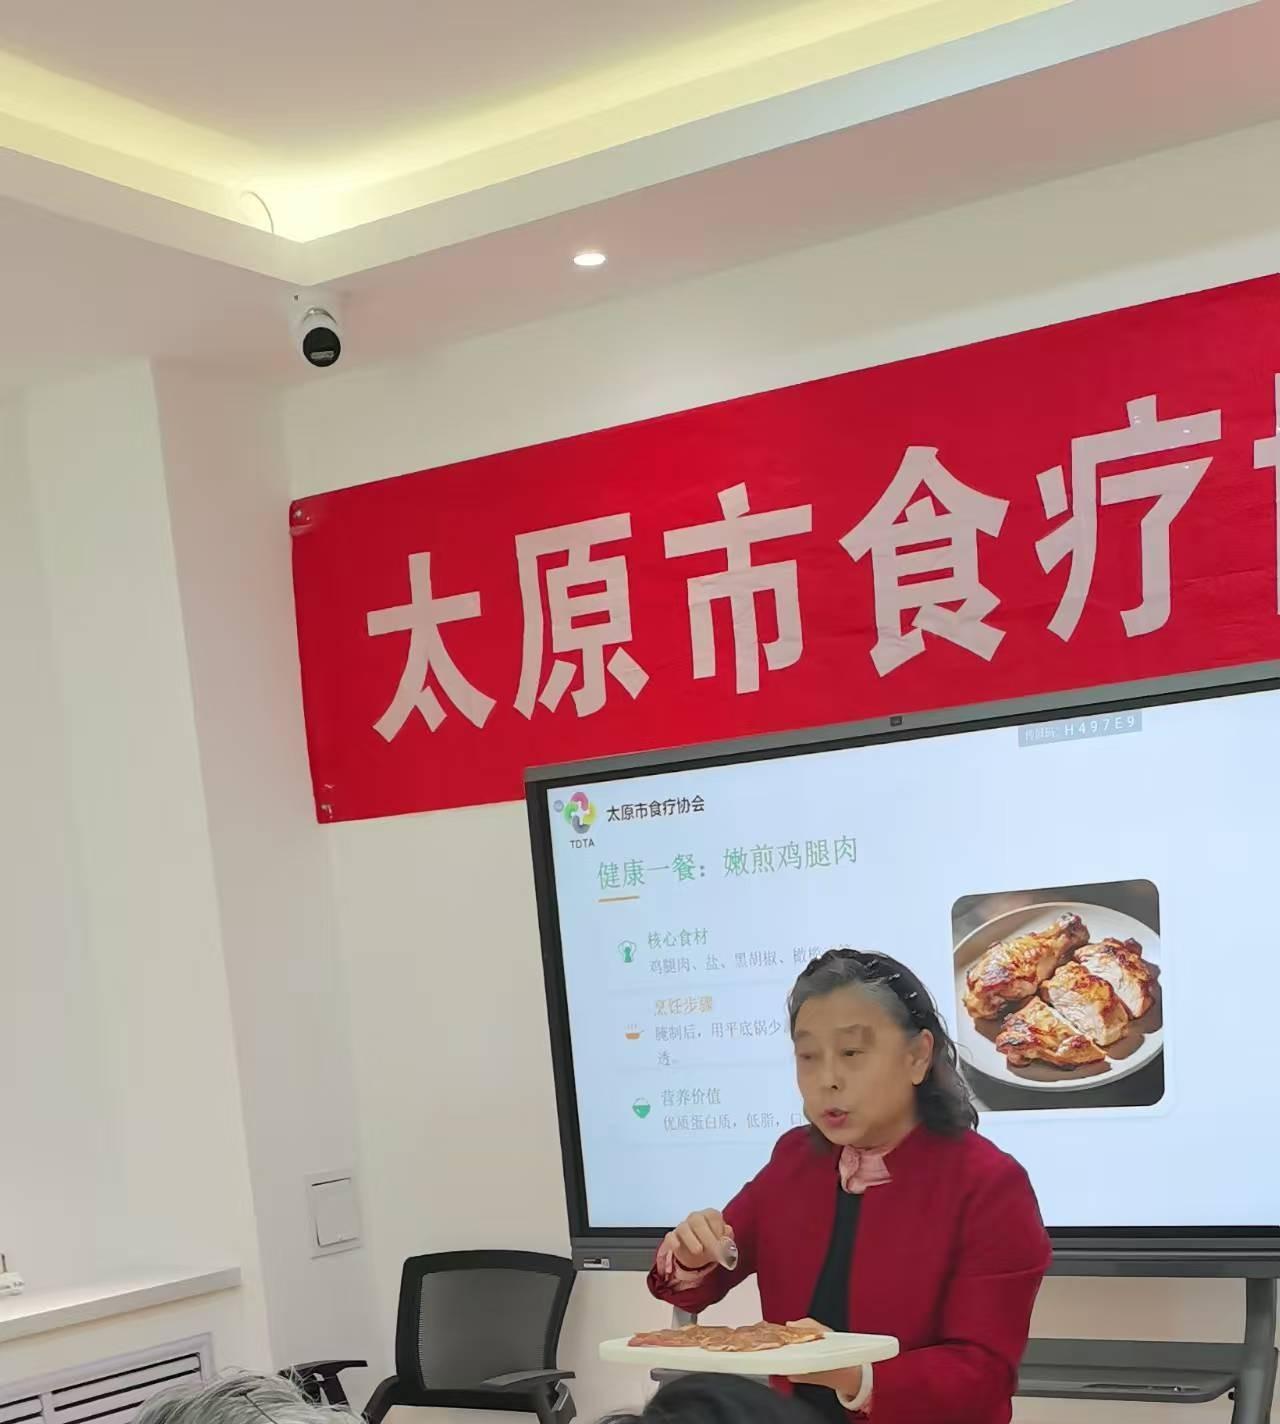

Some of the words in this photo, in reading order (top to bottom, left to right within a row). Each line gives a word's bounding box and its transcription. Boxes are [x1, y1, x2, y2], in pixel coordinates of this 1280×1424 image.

[606, 794, 705, 823] 太原市食疗协会
[570, 838, 596, 849] TDTA
[648, 927, 709, 950] 核心食材
[655, 1019, 790, 1042] 腌制后，用平底锅少
[660, 1087, 721, 1108] 营养价值
